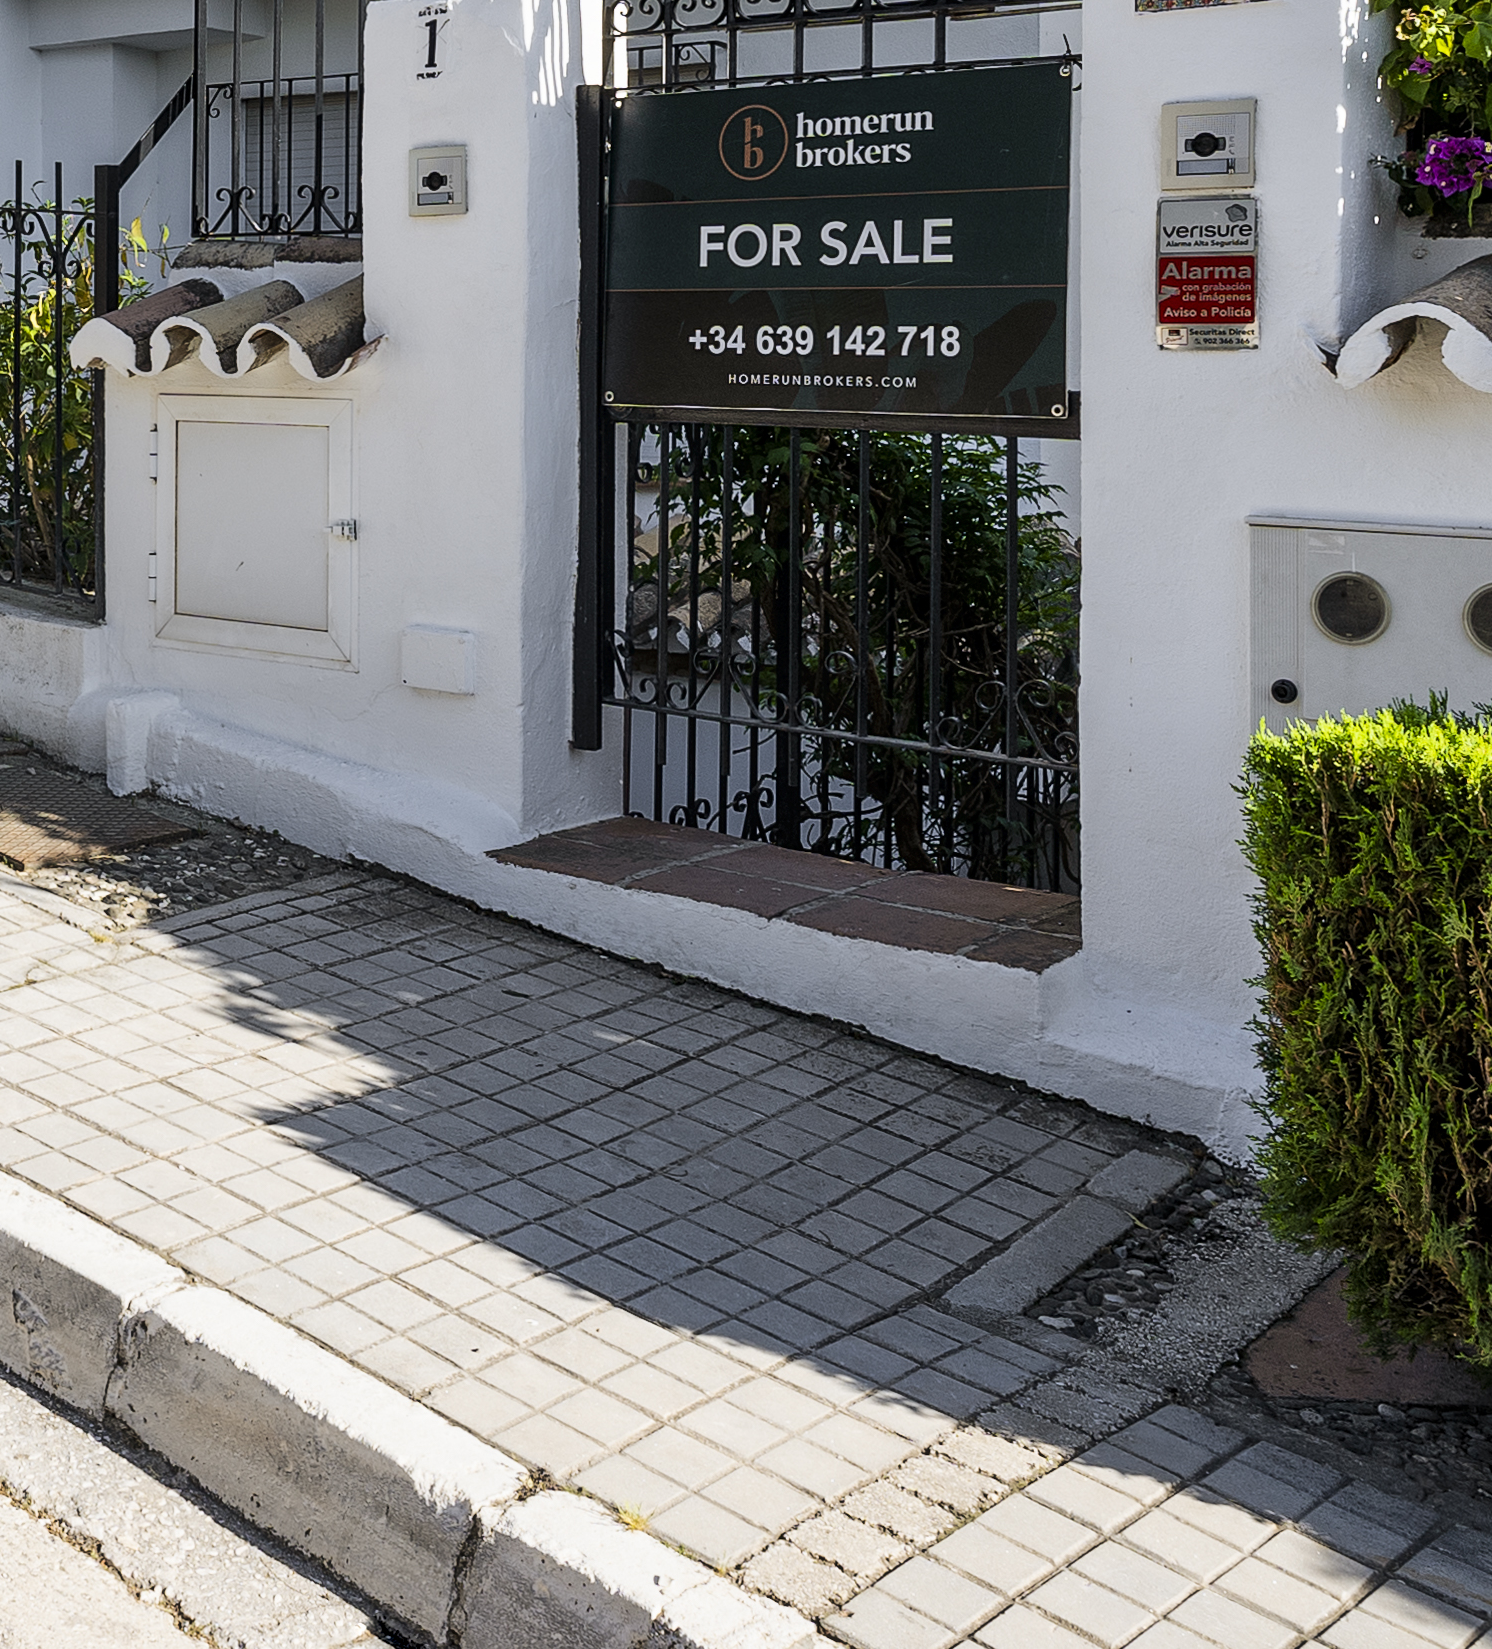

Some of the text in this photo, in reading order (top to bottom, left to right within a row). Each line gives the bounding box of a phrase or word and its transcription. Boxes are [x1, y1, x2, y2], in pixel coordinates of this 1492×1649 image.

[795, 110, 935, 139] homerun
[795, 138, 912, 168] brokers
[1162, 224, 1252, 238] verisure
[698, 217, 954, 267] FOR SALE
[1165, 240, 1192, 248] Alarma
[1211, 239, 1249, 248] Seguridad
[1161, 261, 1252, 279] Alarma
[1182, 281, 1252, 293] con grabación
[1182, 292, 1252, 304] de imágenes
[1164, 306, 1252, 318] Aviso a Policía
[1189, 328, 1227, 336] Securitas
[1228, 328, 1255, 336] Direct
[688, 325, 961, 357] +34 639 142 718
[727, 373, 918, 389] HOMERUNBROKERS.COM
